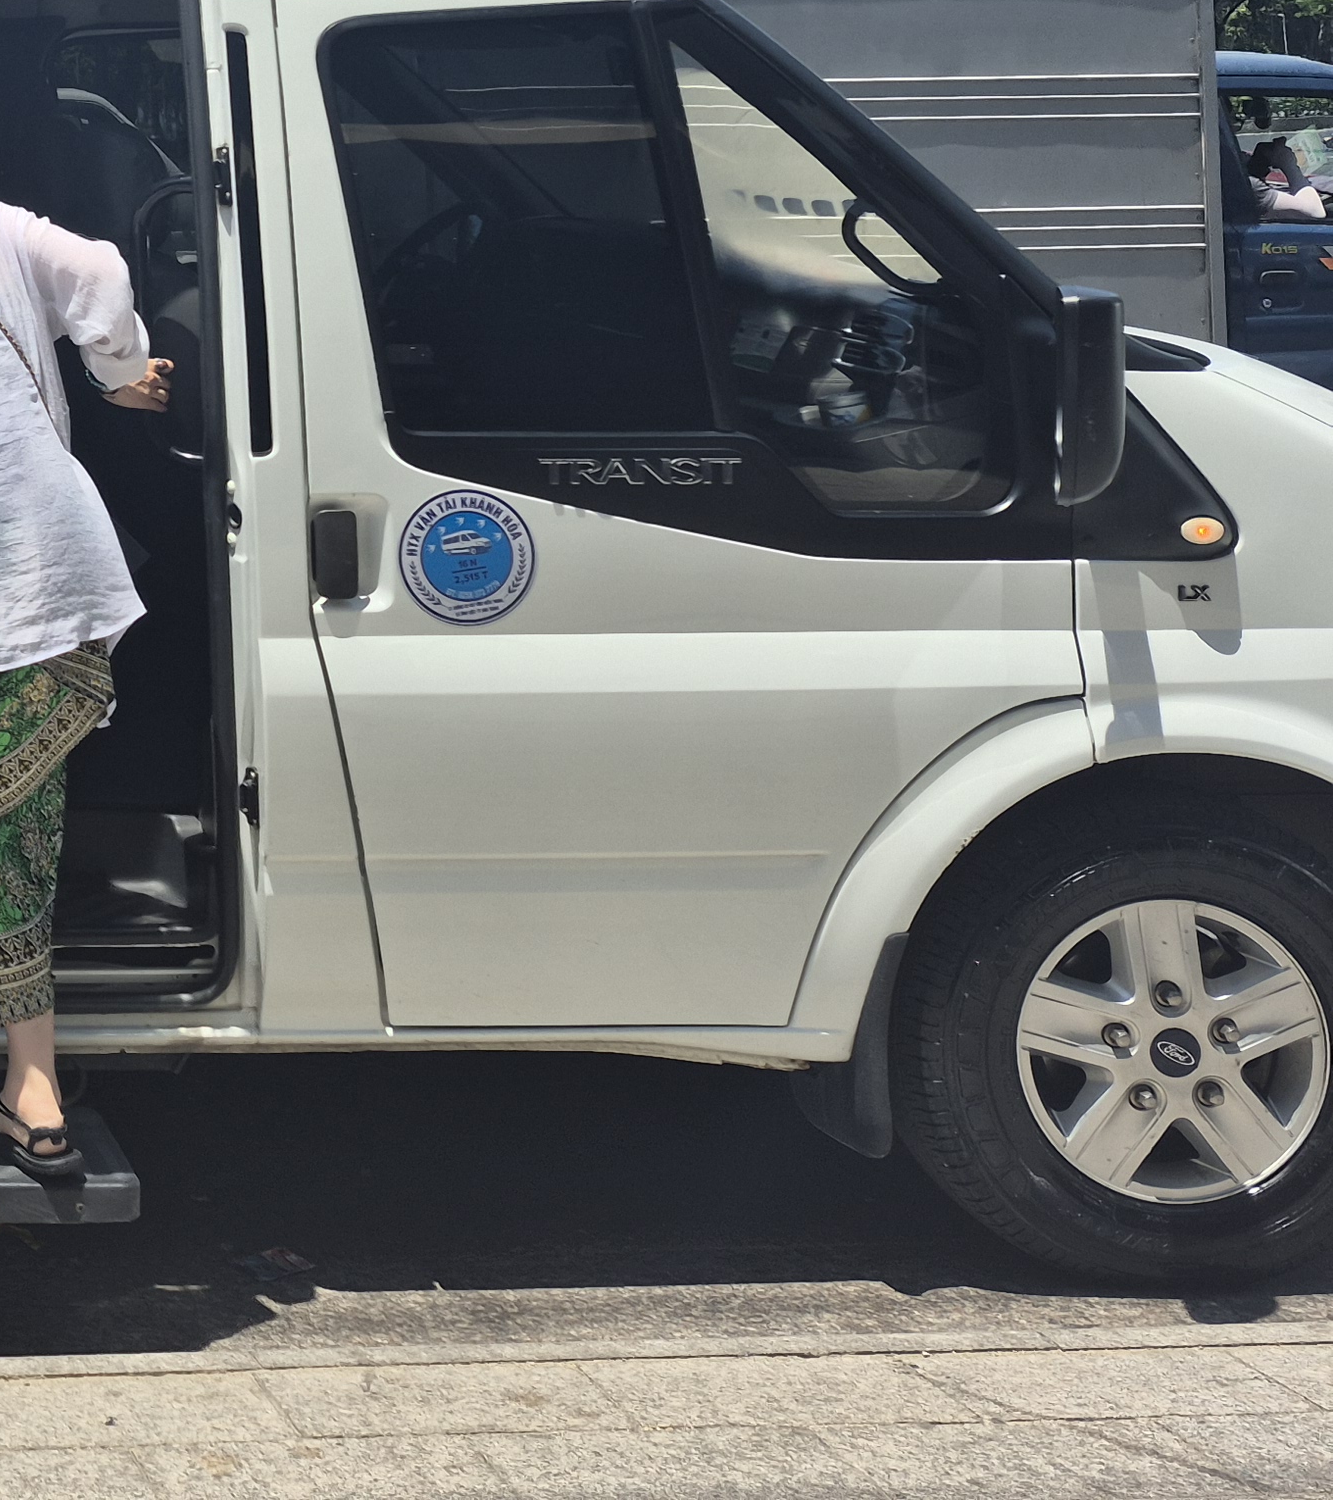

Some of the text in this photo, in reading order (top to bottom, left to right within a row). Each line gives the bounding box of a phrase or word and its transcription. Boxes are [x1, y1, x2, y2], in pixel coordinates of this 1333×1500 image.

[537, 457, 742, 485] TRANSIT
[406, 532, 422, 557] HTX
[1177, 584, 1212, 601] LX
[1163, 1043, 1189, 1062] Ford
